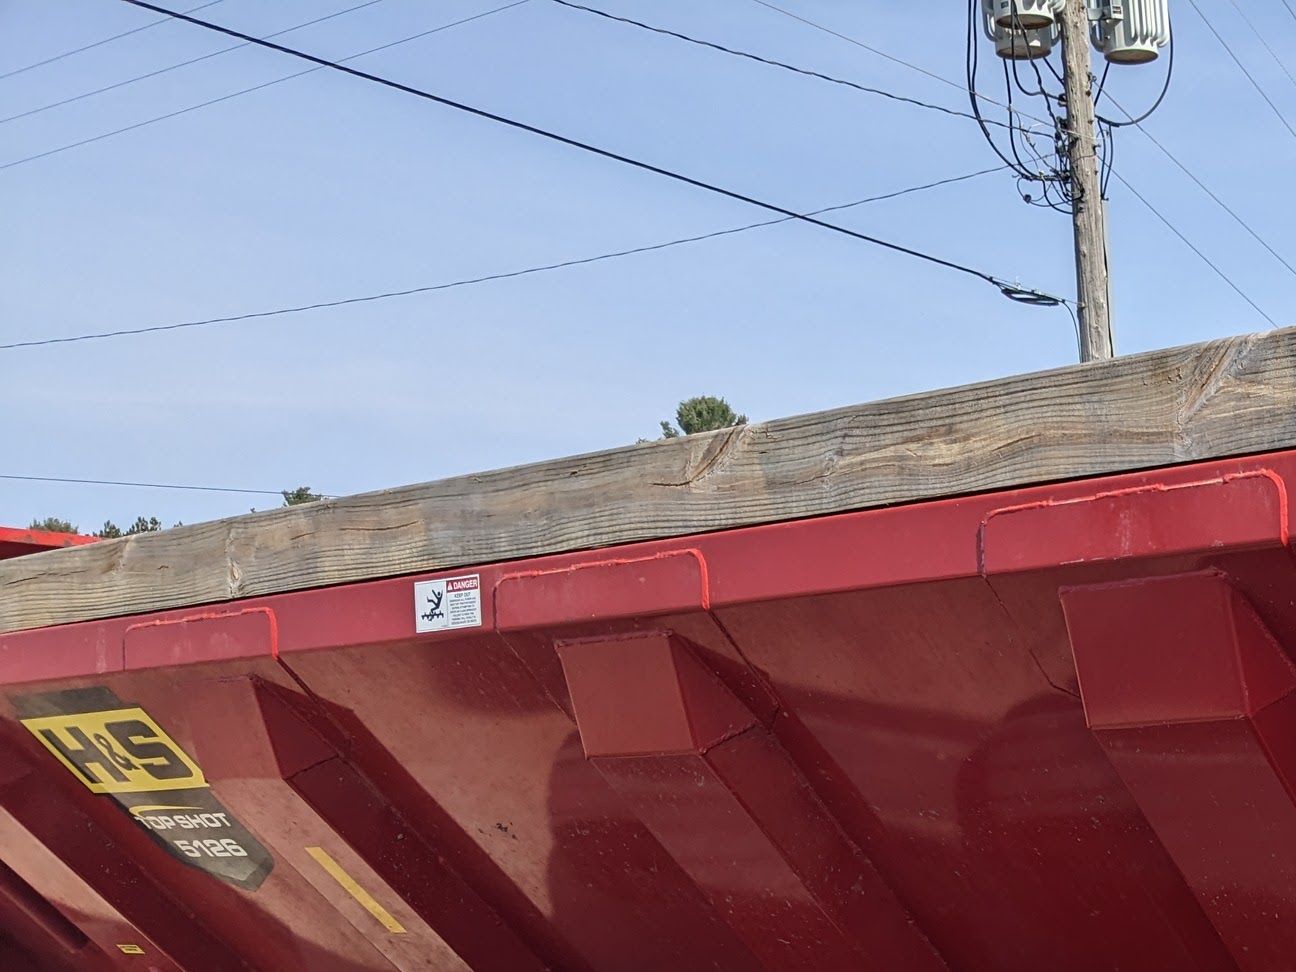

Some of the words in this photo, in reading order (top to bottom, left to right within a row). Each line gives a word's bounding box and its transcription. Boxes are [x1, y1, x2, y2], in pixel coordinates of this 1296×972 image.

[452, 579, 478, 590] DANGER
[37, 719, 194, 784] H&S
[134, 815, 177, 831] TOP
[178, 812, 232, 829] SHOT
[173, 838, 248, 859] 5126
